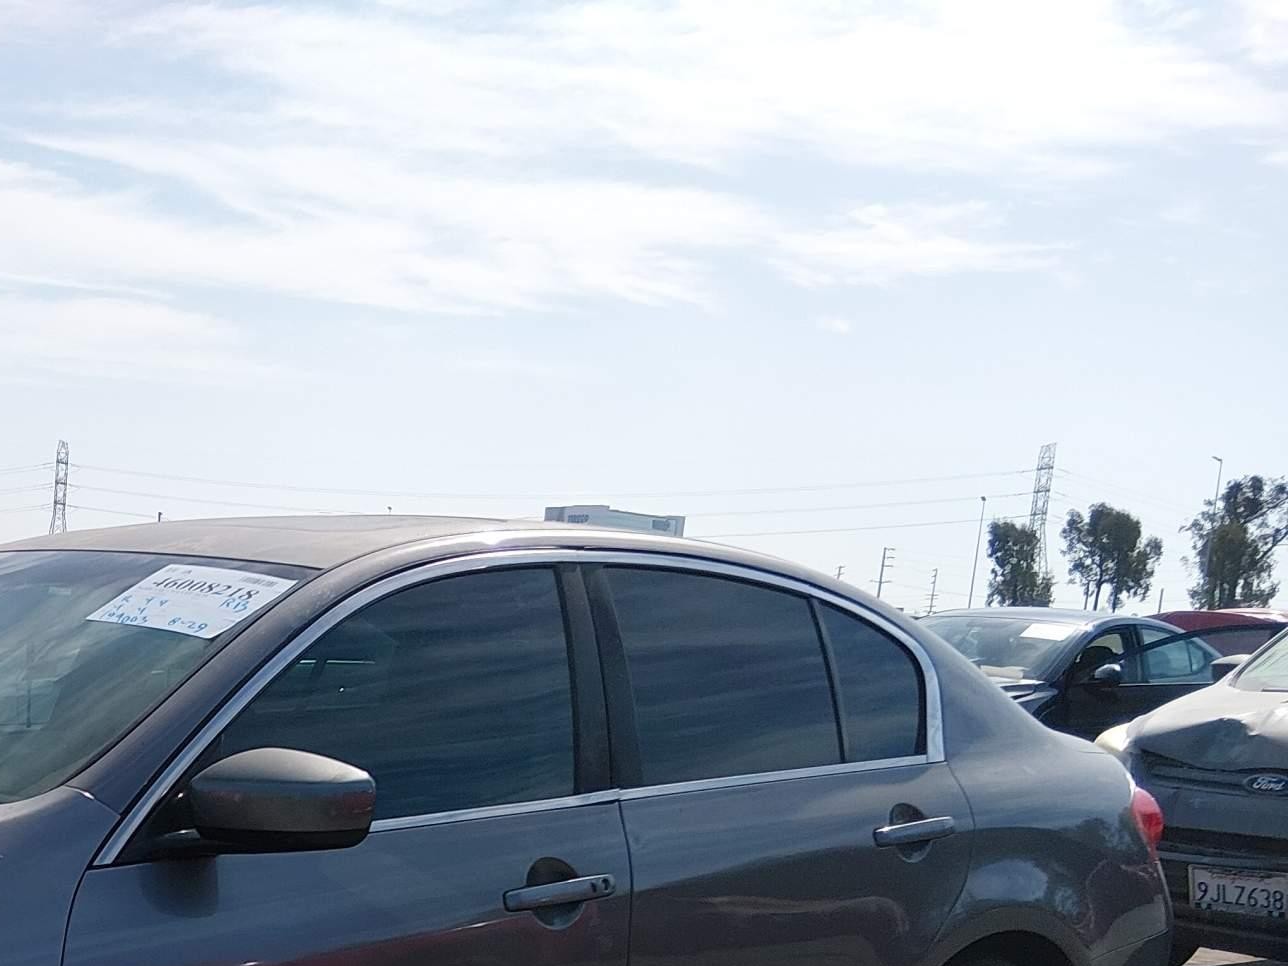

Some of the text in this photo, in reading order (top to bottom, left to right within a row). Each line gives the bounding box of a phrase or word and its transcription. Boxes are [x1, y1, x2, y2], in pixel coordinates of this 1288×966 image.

[153, 577, 260, 601] 46008218
[1253, 776, 1285, 791] Ford
[1197, 881, 1284, 911] 9JLZ638
